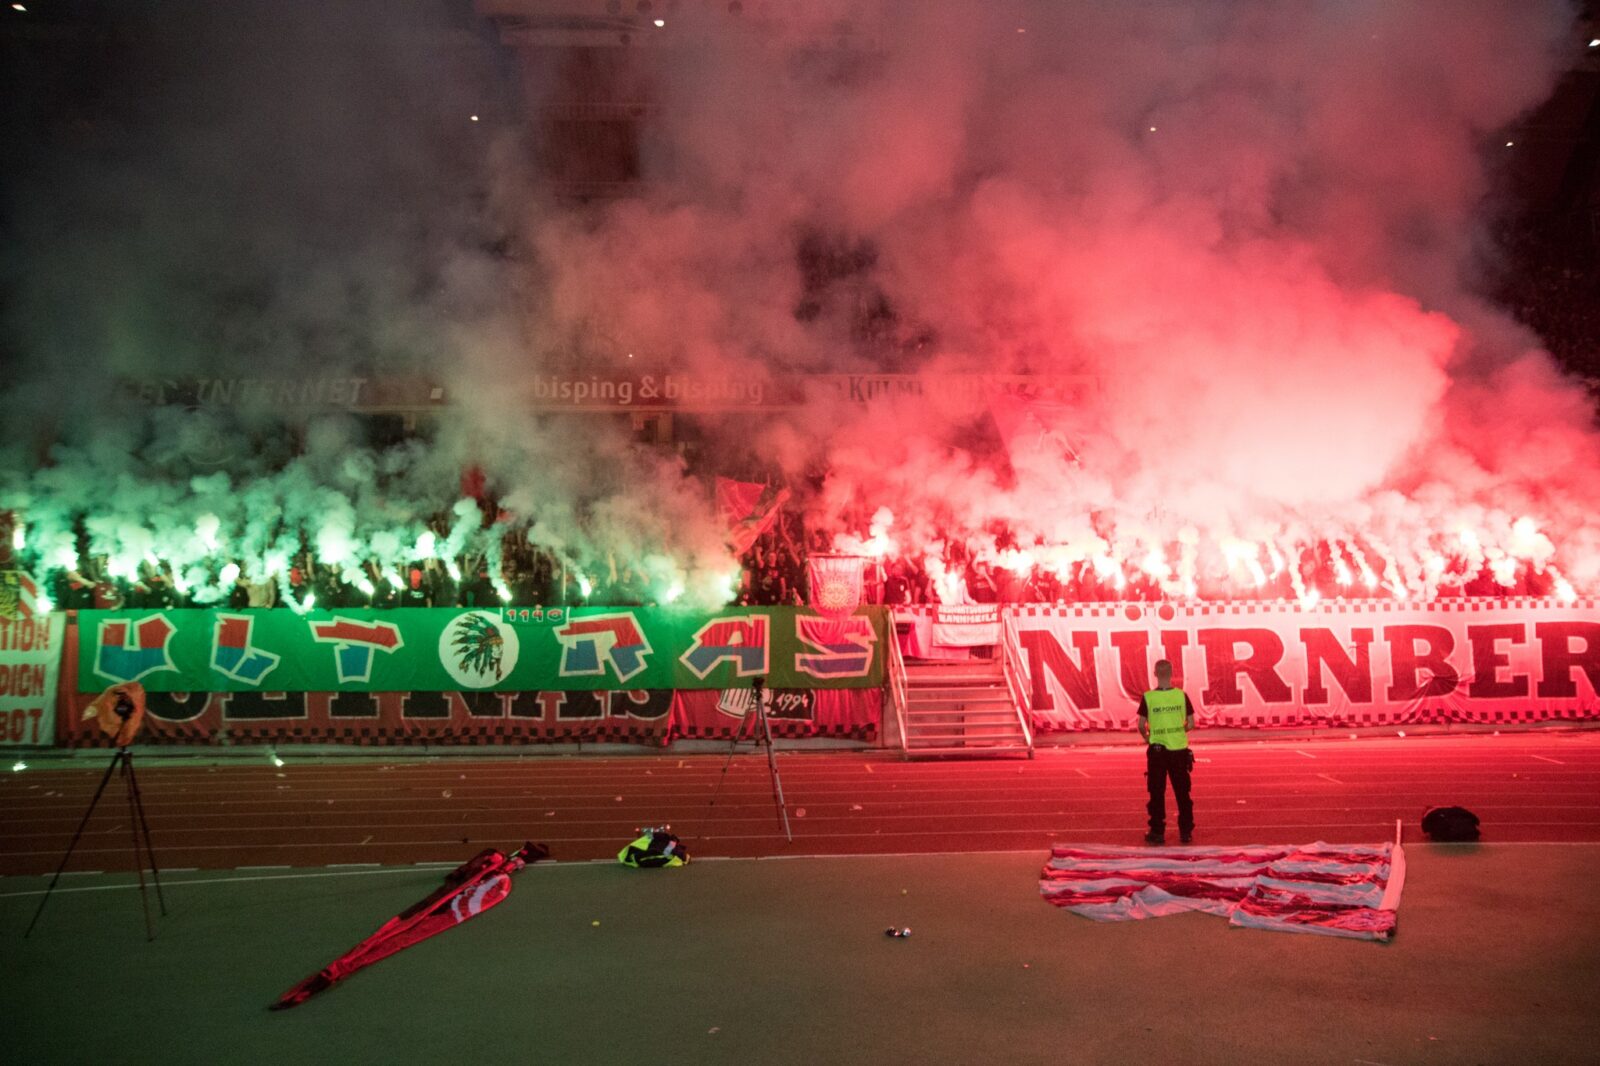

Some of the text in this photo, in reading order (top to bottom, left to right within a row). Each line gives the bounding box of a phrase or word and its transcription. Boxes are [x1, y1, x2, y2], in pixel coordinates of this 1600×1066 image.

[196, 378, 368, 403] INTERNET
[534, 374, 763, 404] bisping & bisping
[1018, 602, 1600, 711] NÜRNBER
